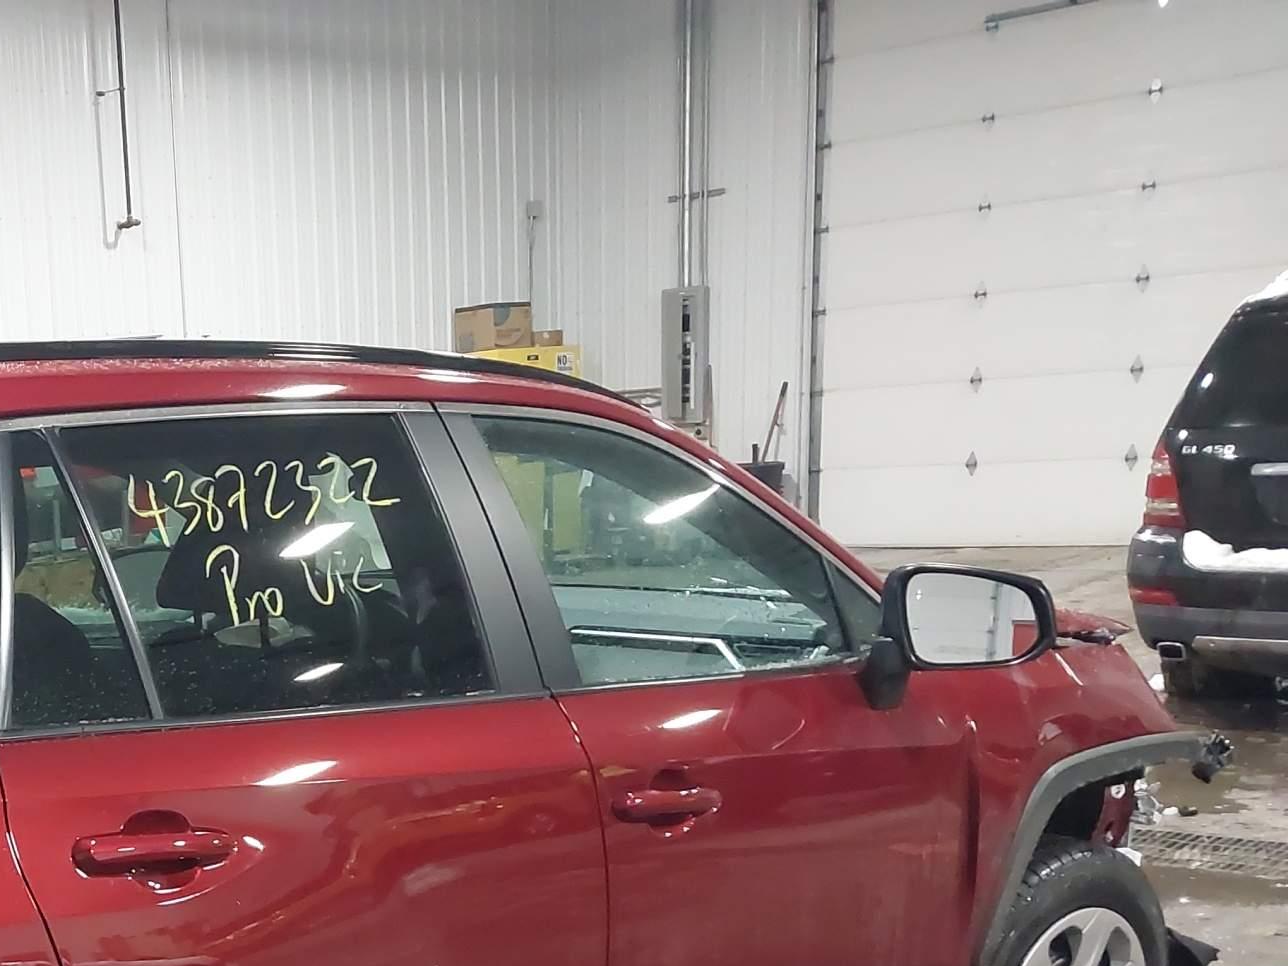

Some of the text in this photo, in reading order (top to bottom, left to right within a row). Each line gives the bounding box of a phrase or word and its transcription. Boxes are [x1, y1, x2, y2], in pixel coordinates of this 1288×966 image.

[1202, 444, 1236, 455] 450
[126, 451, 401, 548] 43872322
[205, 544, 284, 627] Pro
